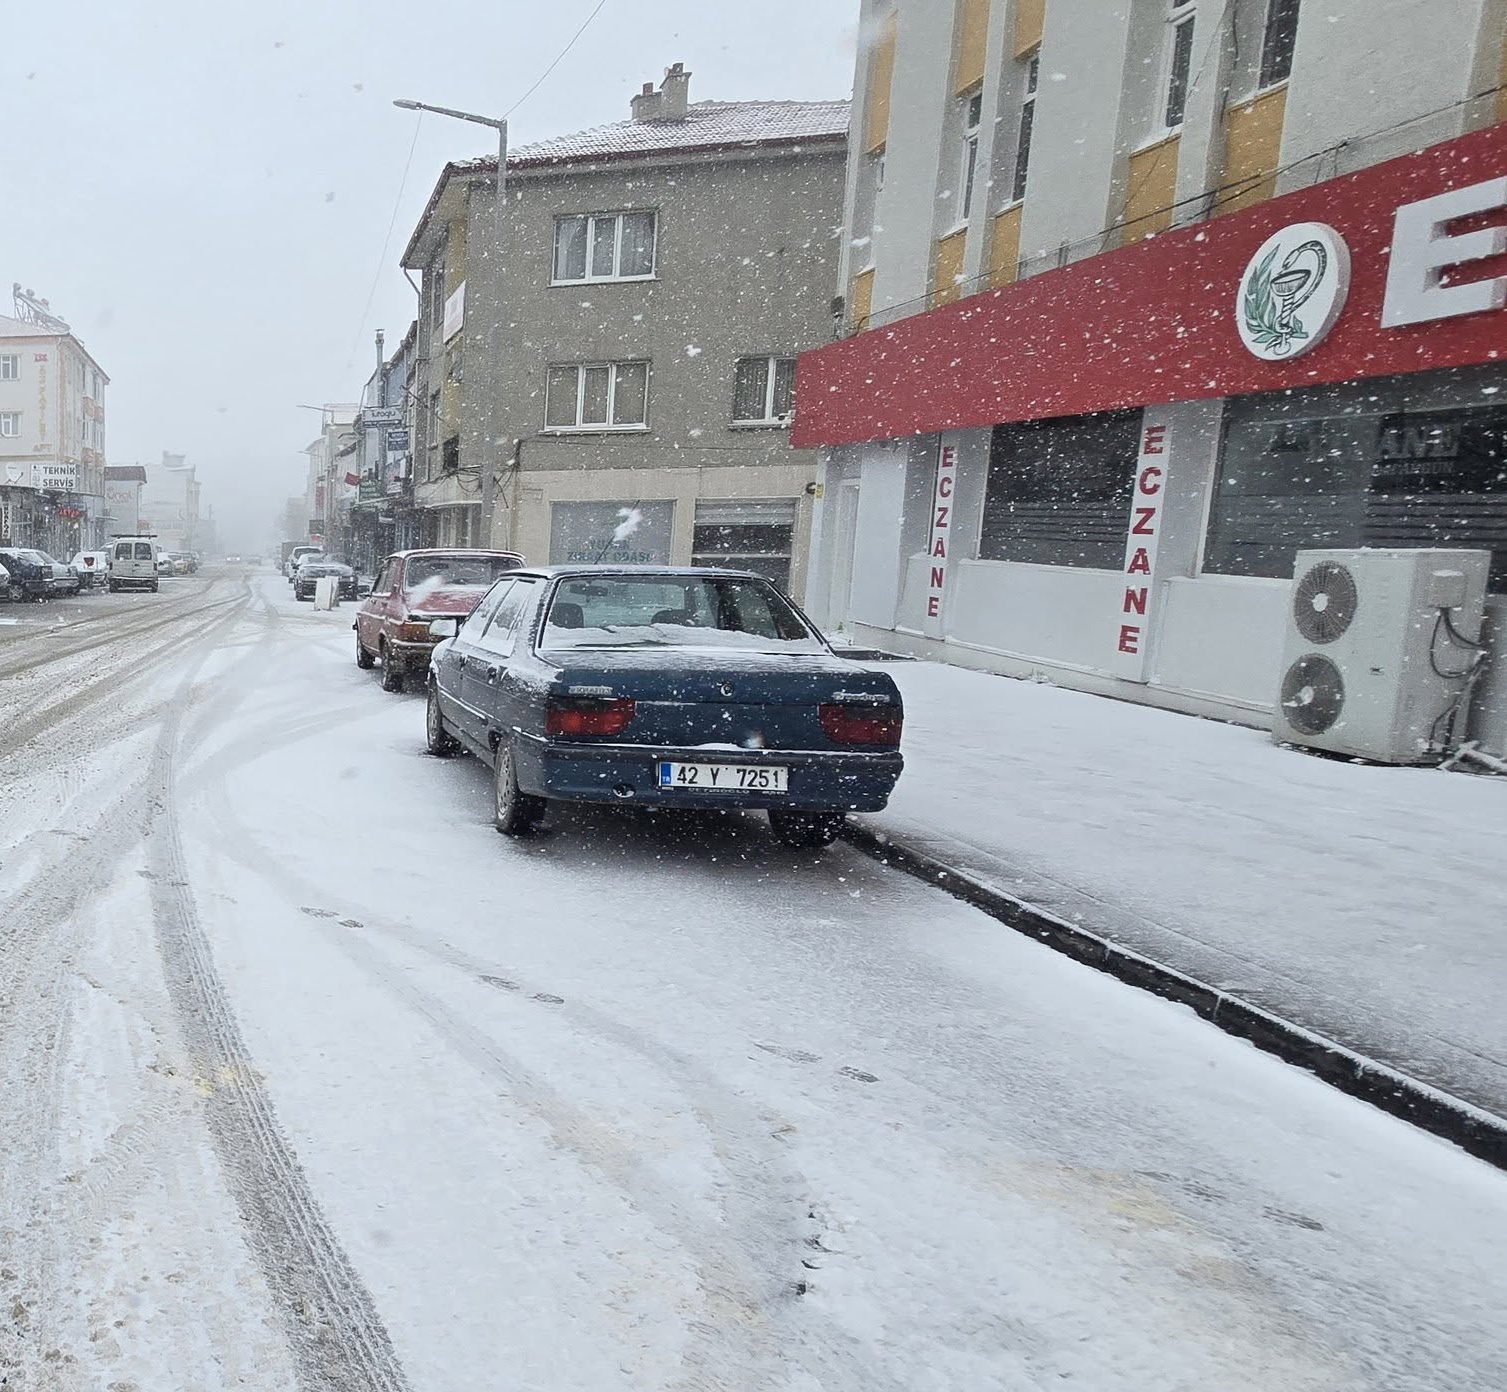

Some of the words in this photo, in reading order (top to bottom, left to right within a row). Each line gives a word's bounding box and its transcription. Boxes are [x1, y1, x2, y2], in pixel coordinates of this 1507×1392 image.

[43, 465, 75, 475] TEKNİK
[43, 477, 74, 487] SERVİS
[928, 446, 956, 617] ECZANE
[1118, 425, 1166, 654] ECZANE
[677, 766, 698, 784] 42
[710, 767, 720, 785] Y
[737, 768, 779, 788] 7251
